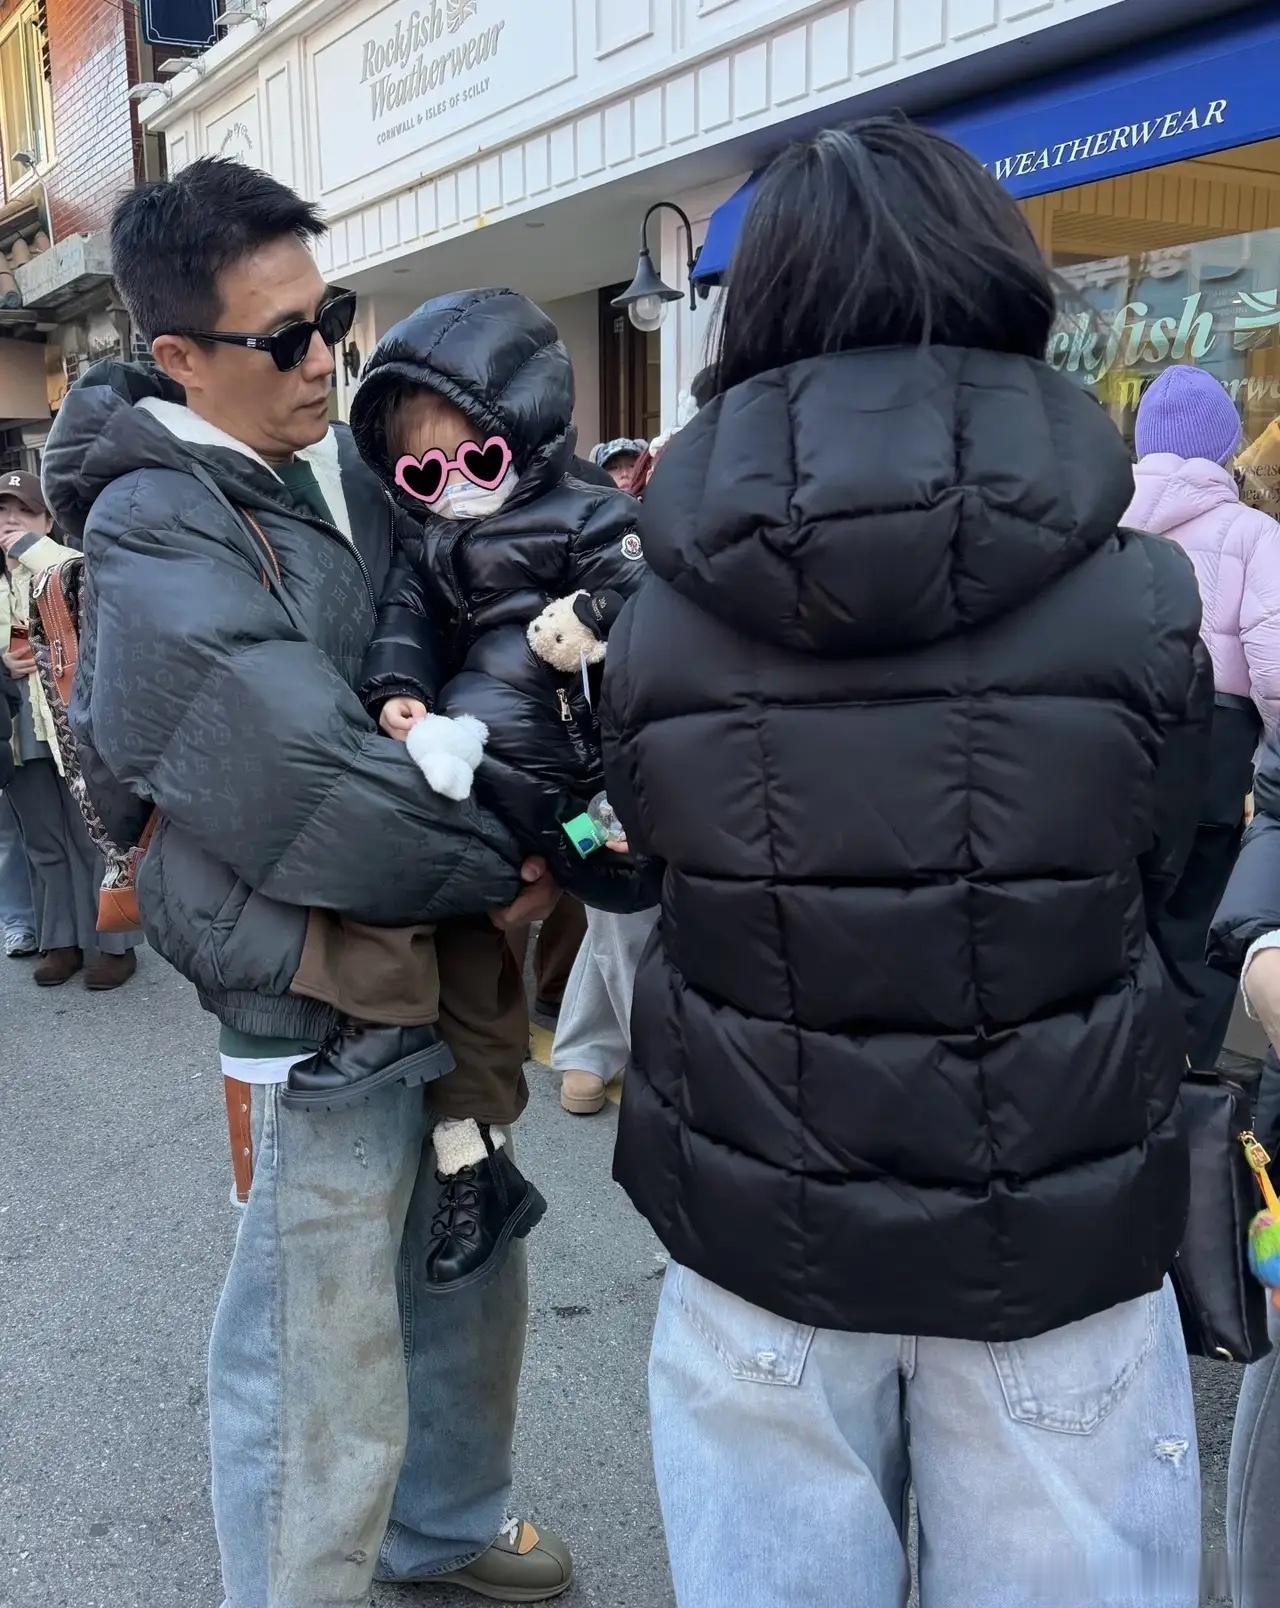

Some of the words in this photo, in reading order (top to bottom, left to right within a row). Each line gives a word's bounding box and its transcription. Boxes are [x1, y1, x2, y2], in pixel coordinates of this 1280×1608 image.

[360, 0, 444, 84] Rockfish
[369, 20, 505, 121] Weatherwear
[376, 117, 415, 145] CORNWALL
[417, 113, 423, 125] &
[425, 100, 447, 121] ISLES
[449, 93, 460, 108] OF
[462, 77, 490, 102] SCILLY
[995, 99, 1227, 181] WEATHERWEAR
[1045, 291, 1216, 385] ckfish
[8, 475, 21, 487] R
